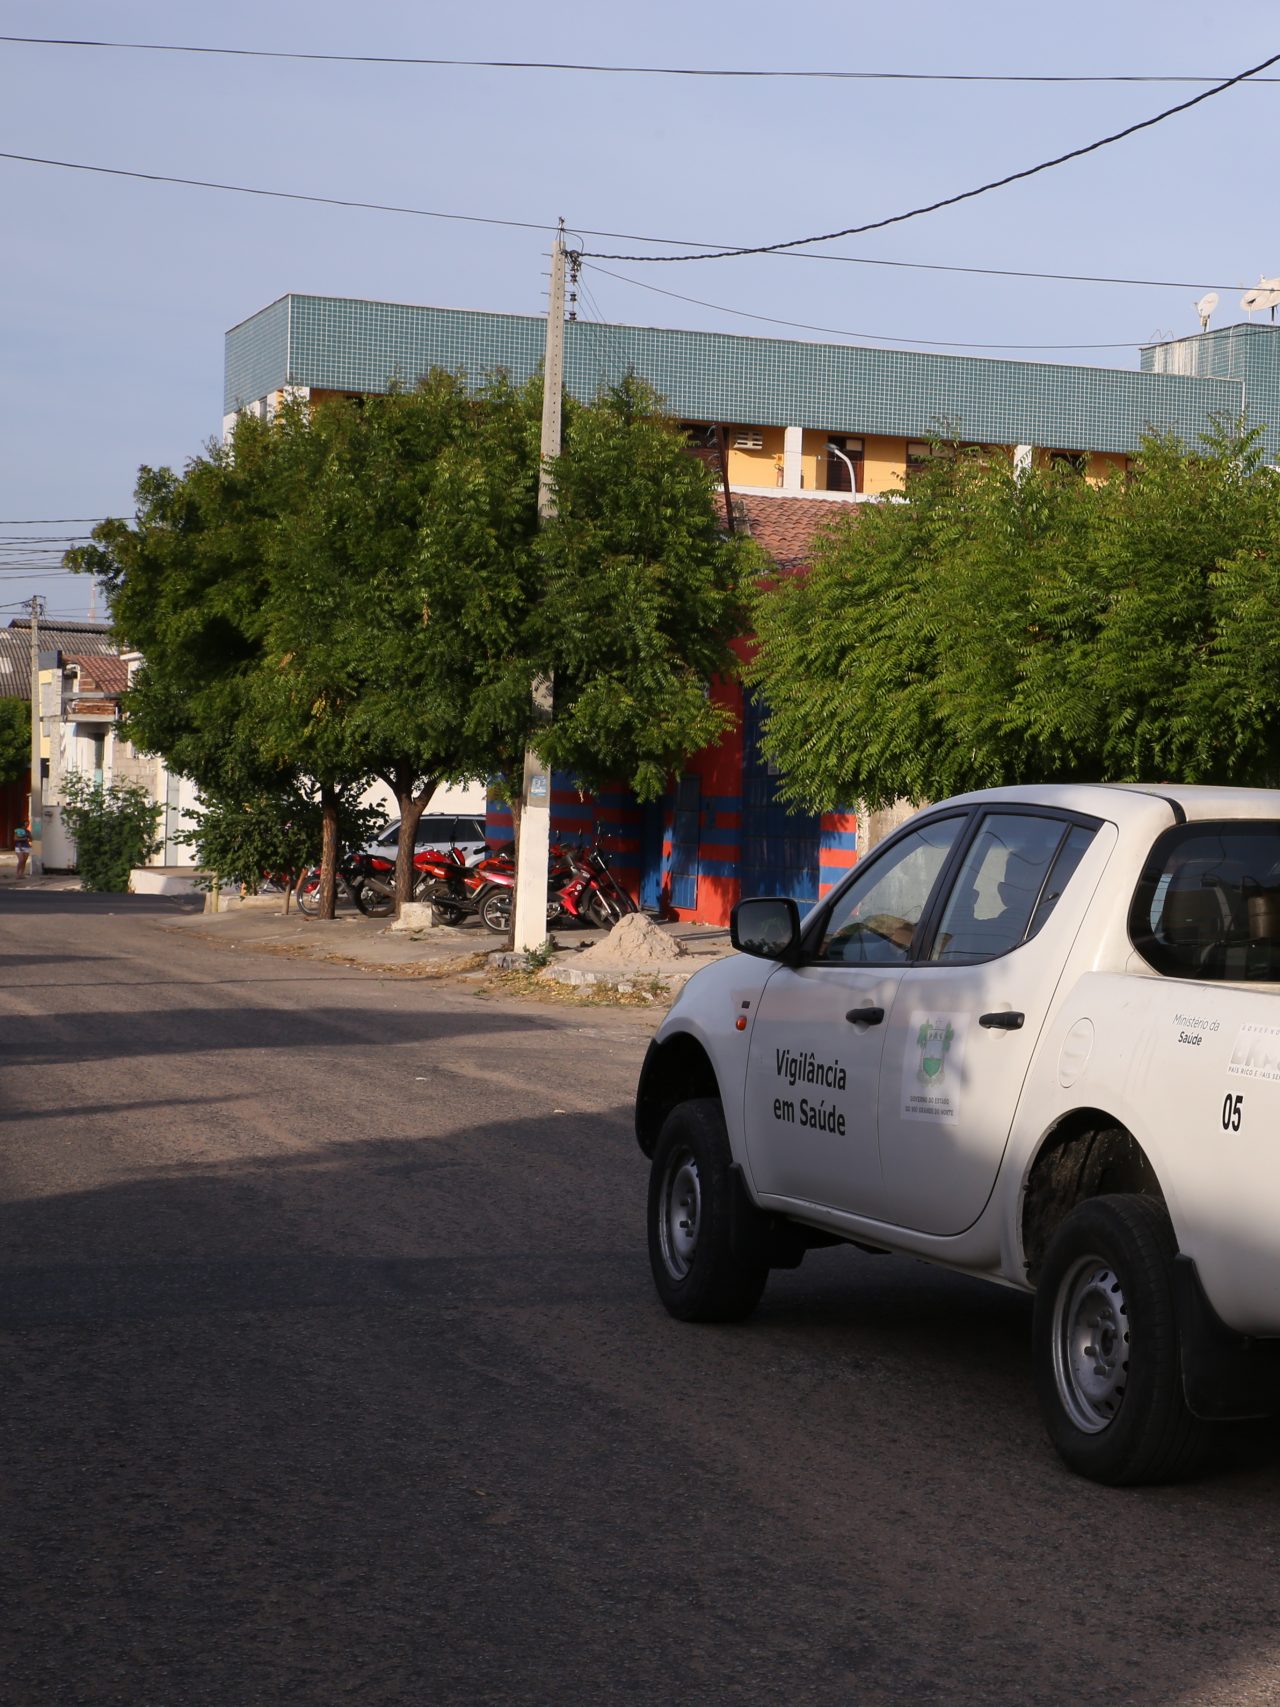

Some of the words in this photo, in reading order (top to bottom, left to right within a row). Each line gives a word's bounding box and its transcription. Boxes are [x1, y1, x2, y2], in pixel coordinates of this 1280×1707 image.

[1172, 1014, 1209, 1030] Ministério
[1209, 1020, 1221, 1031] da
[1178, 1030, 1203, 1046] Saúde
[776, 1048, 846, 1090] Vigilância
[773, 1098, 794, 1123] em
[799, 1098, 846, 1136] Saúde
[1222, 1093, 1244, 1132] 05
